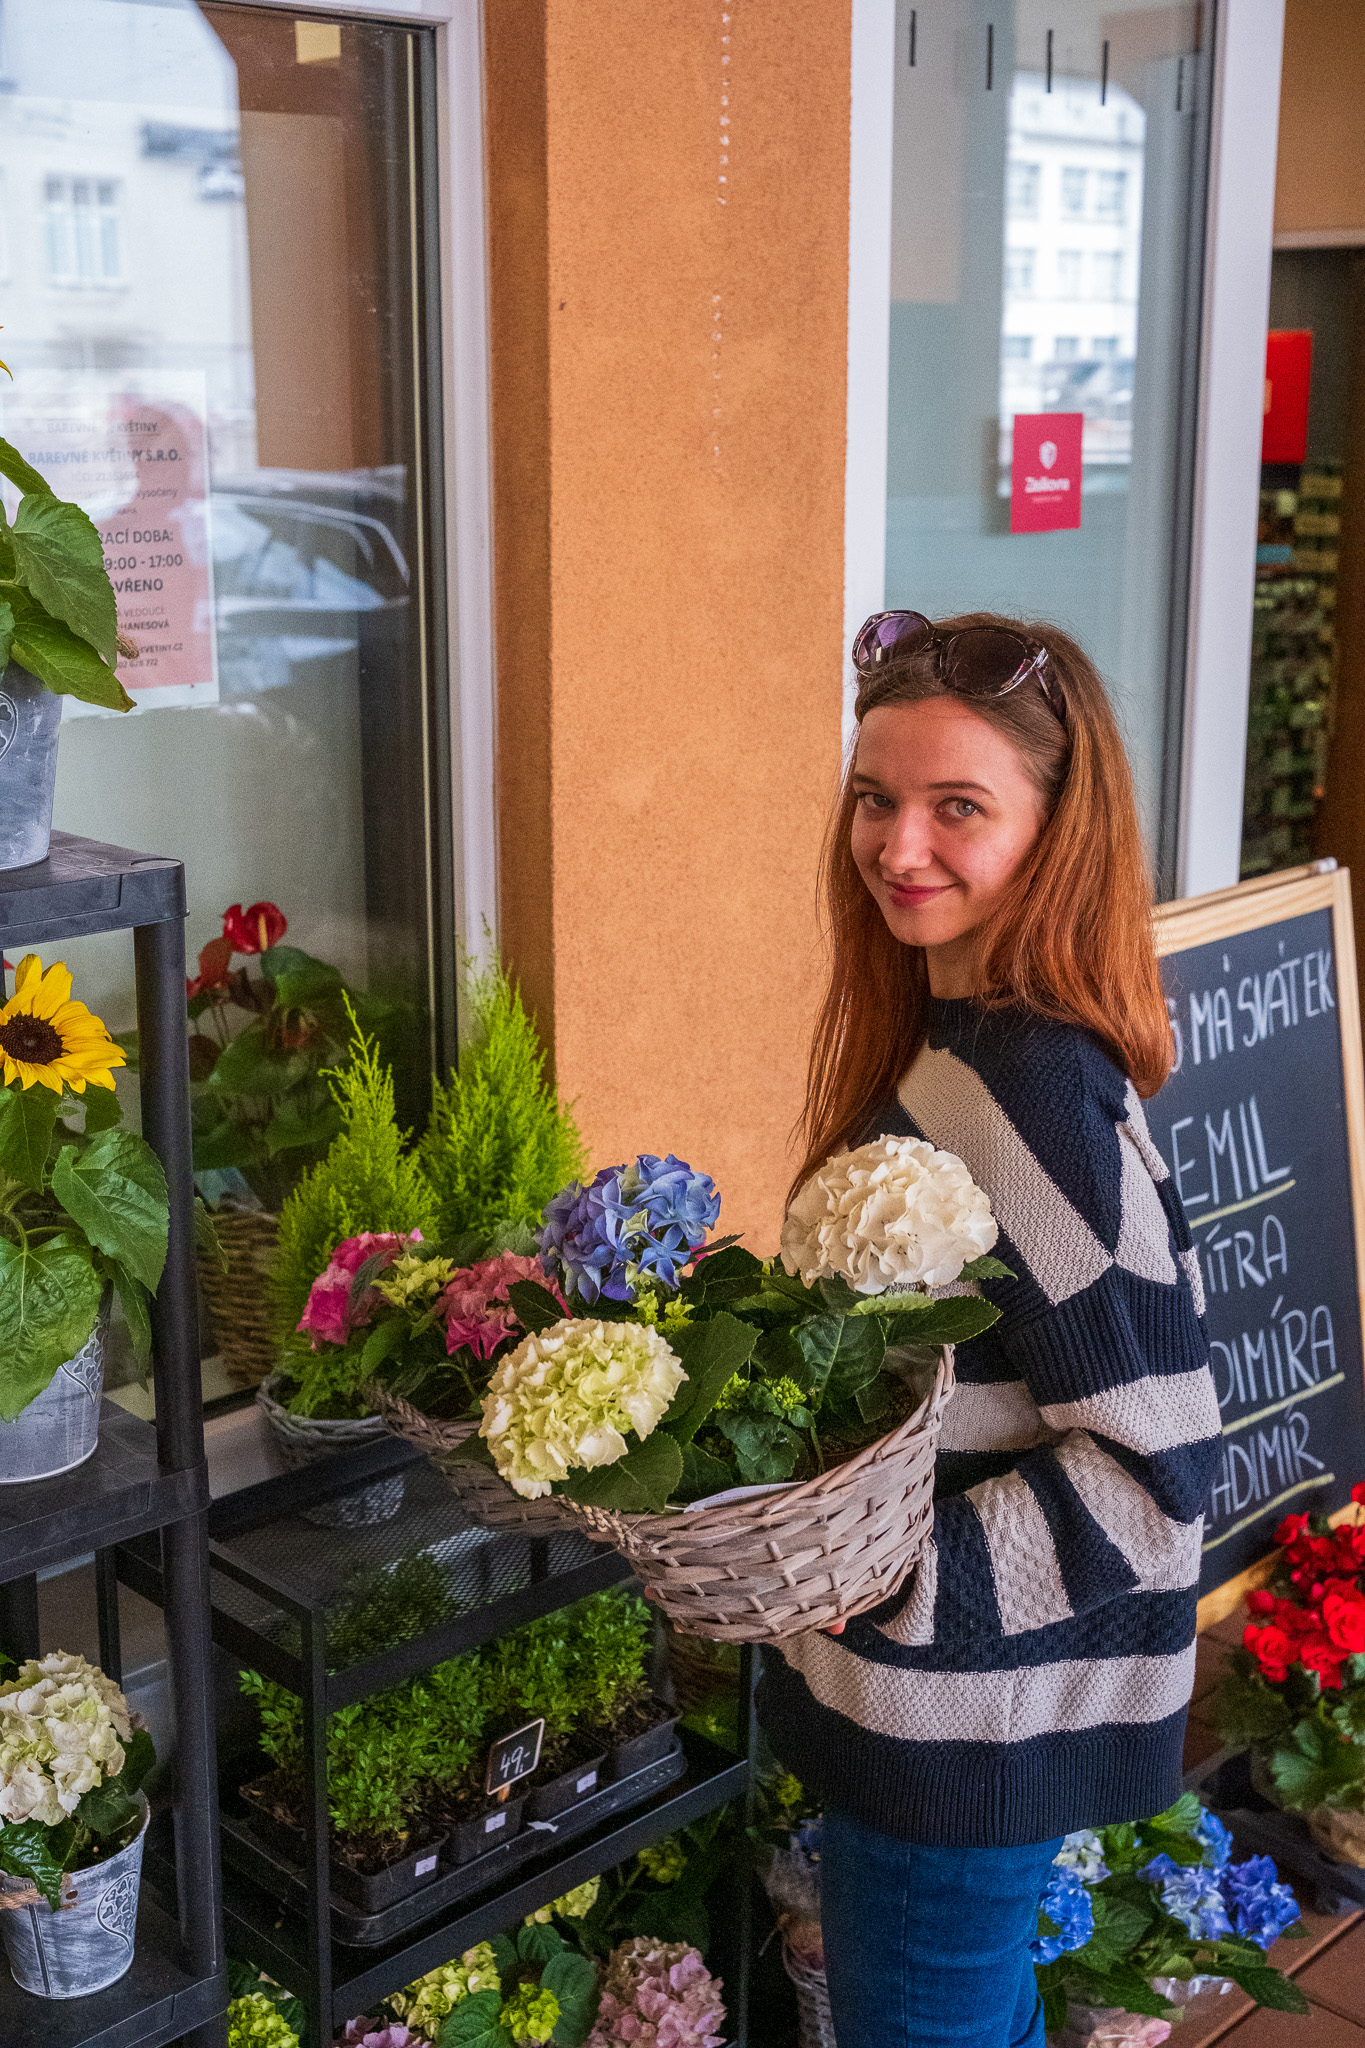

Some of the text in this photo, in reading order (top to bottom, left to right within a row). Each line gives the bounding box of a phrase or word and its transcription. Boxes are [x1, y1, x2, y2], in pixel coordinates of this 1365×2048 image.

[28, 448, 89, 464] BAREVNÉ
[146, 448, 183, 462] S.R.O.
[133, 529, 174, 543] DOBA:
[149, 554, 183, 569] 17:00
[114, 578, 164, 593] VŘENO
[1189, 953, 1235, 1066] MÁ
[1237, 940, 1336, 1047] SVÁTEK
[1170, 1096, 1293, 1207] EMIL
[1205, 1214, 1288, 1294] ÍTRA
[1209, 1295, 1338, 1408] DIMÍRA
[1210, 1402, 1326, 1517] ADIMÍR
